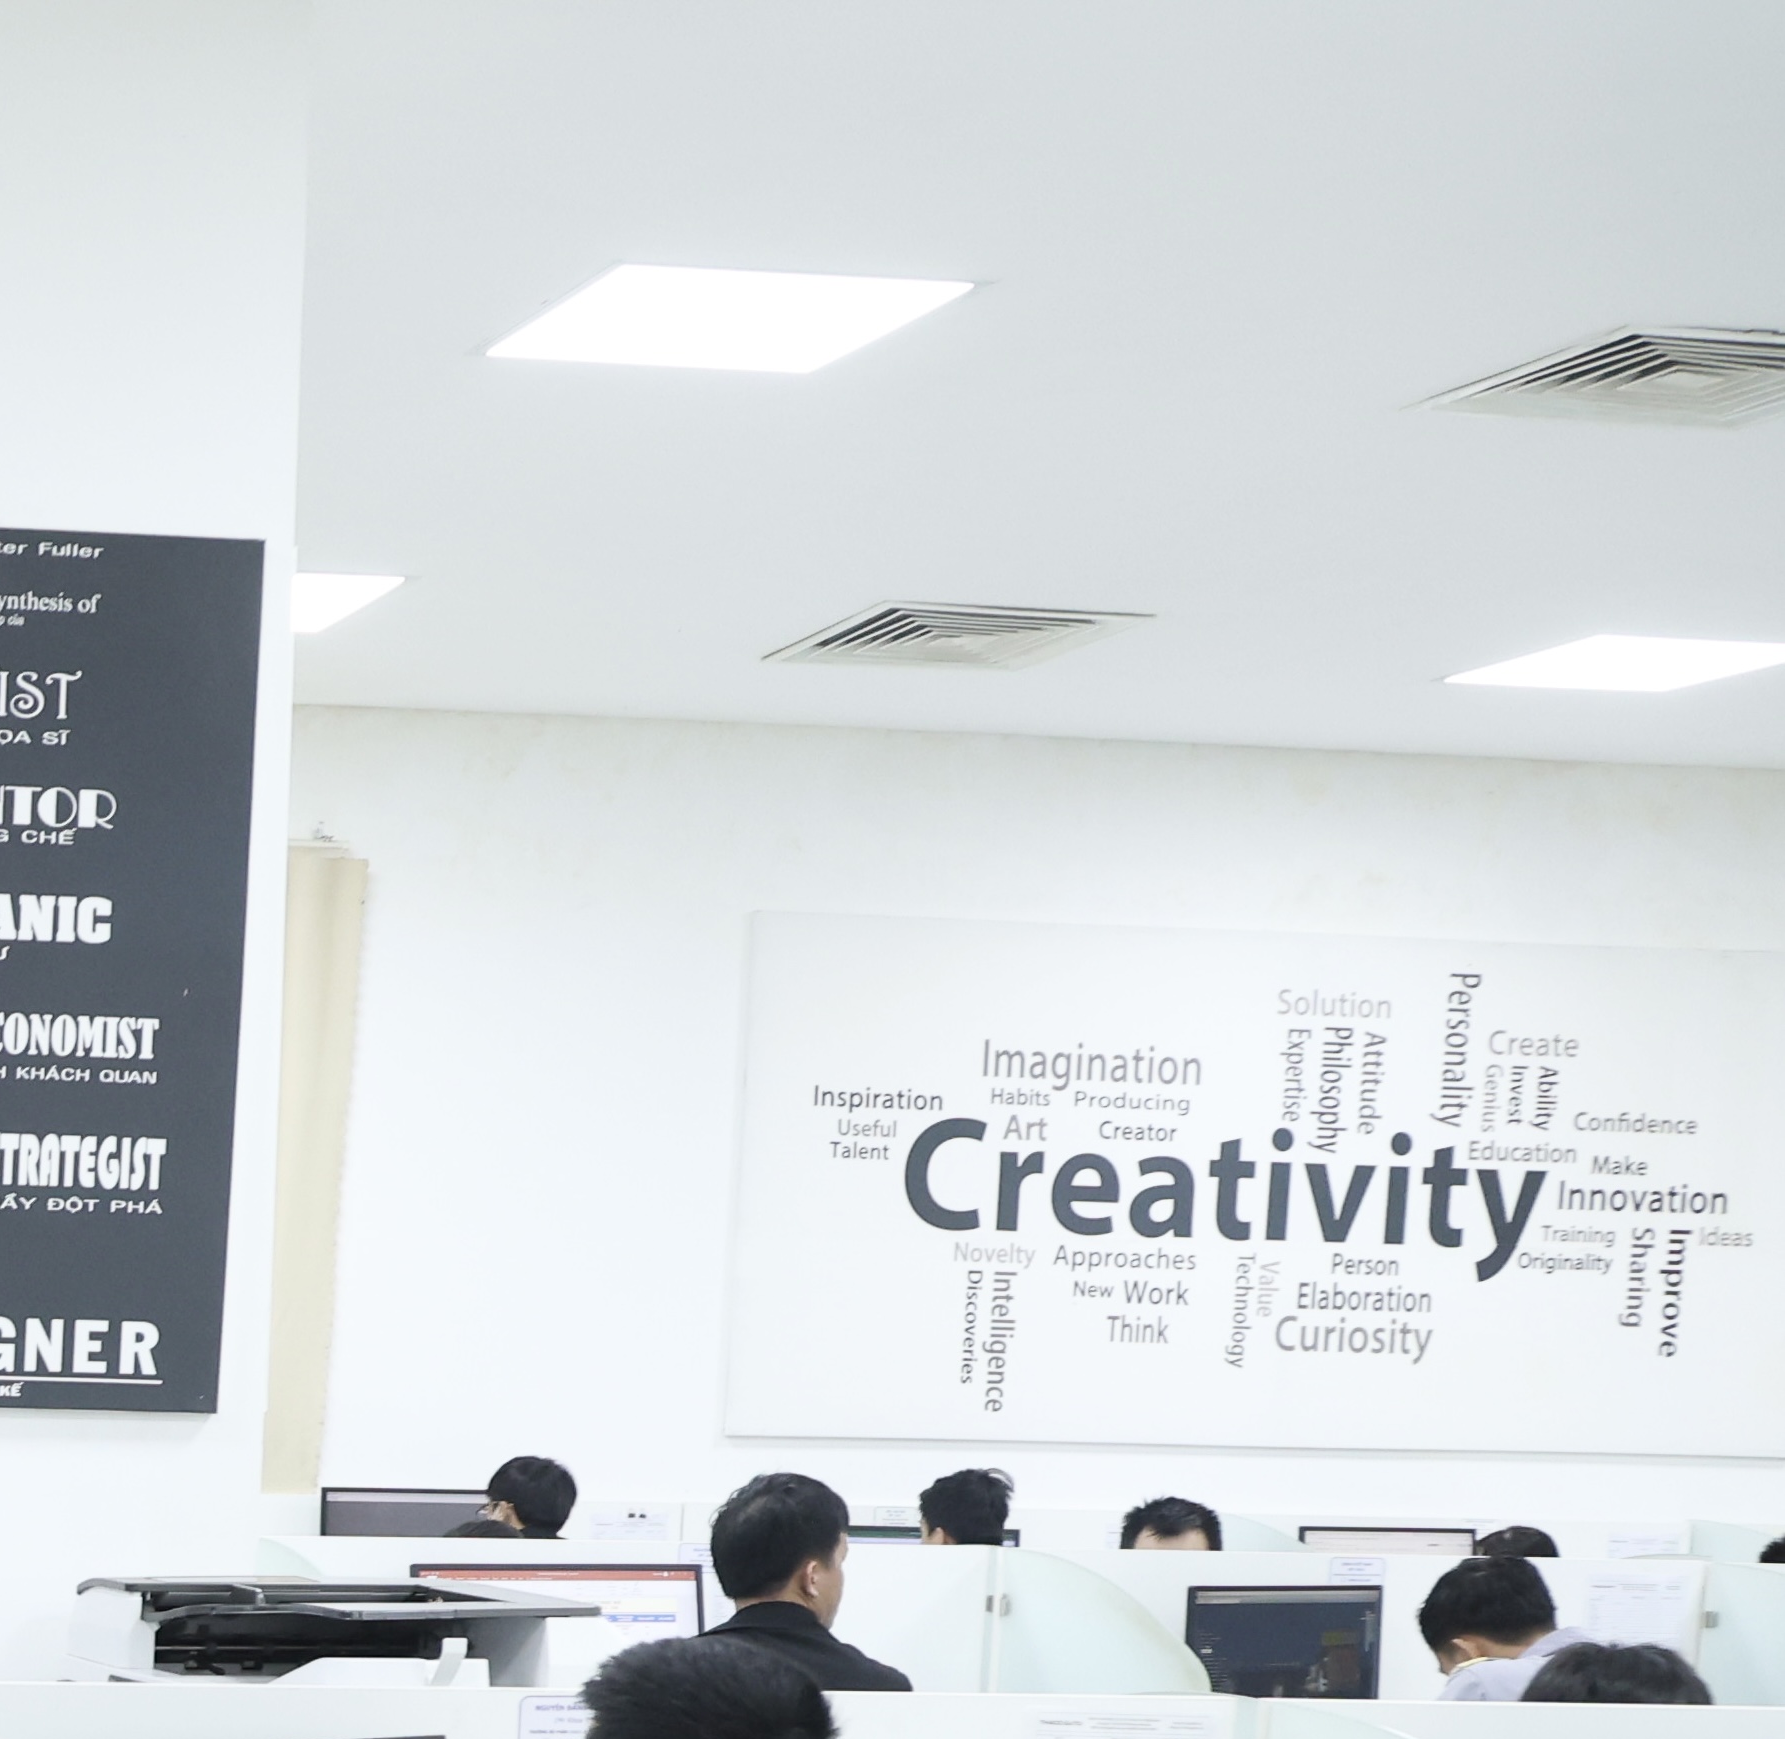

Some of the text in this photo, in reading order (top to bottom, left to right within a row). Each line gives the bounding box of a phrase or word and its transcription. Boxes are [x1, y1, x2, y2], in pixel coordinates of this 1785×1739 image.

[38, 542, 104, 560] Fuller
[77, 595, 100, 613] of
[42, 728, 71, 746] SĨ
[21, 827, 78, 845] CHẾ
[1277, 989, 1392, 1019] Solution
[1430, 972, 1481, 1129] Personality
[1489, 1029, 1579, 1059] Create
[15, 1064, 90, 1082] KHÁCH
[99, 1068, 158, 1085] QUAN
[982, 1039, 1202, 1091] Imagination
[1281, 1028, 1312, 1122] Expertise
[990, 1087, 1051, 1107] Habits
[1309, 1025, 1354, 1154] Philosophy
[1356, 1032, 1388, 1136] Attitude
[1480, 1063, 1504, 1133] Genius
[1507, 1064, 1528, 1125] Invest
[1529, 1066, 1559, 1130] Ability
[812, 1085, 944, 1113] Inspiration
[1074, 1091, 1191, 1116] Producing
[837, 1119, 898, 1138] Useful
[1003, 1114, 1049, 1142] Art
[1098, 1121, 1177, 1142] Creator
[1573, 1112, 1698, 1136] Confidence
[830, 1142, 890, 1161] Talent
[1469, 1141, 1577, 1165] Education
[1591, 1156, 1649, 1177] Make
[47, 1194, 99, 1214] ĐỘT
[110, 1196, 163, 1215] PHÁ
[904, 1115, 1547, 1282] Creativity
[1558, 1181, 1729, 1215] Innovation
[1542, 1225, 1616, 1248] Training
[1699, 1227, 1753, 1248] Ideas
[953, 1241, 1036, 1268] Novelty
[1053, 1245, 1197, 1272] Approaches
[1331, 1253, 1399, 1276] Person
[1517, 1252, 1613, 1275] Originality
[1256, 1261, 1280, 1318] Value
[1618, 1227, 1655, 1328] Sharing
[1073, 1280, 1189, 1306] New Work
[1296, 1282, 1432, 1313] Elaboration
[1657, 1229, 1691, 1358] Improve
[1224, 1252, 1256, 1369] Technology
[960, 1269, 984, 1384] Discoveries
[1107, 1315, 1169, 1344] Think
[1275, 1315, 1433, 1366] Curiosity
[982, 1271, 1017, 1413] Intelligence
[0, 1381, 24, 1398] KẾ
